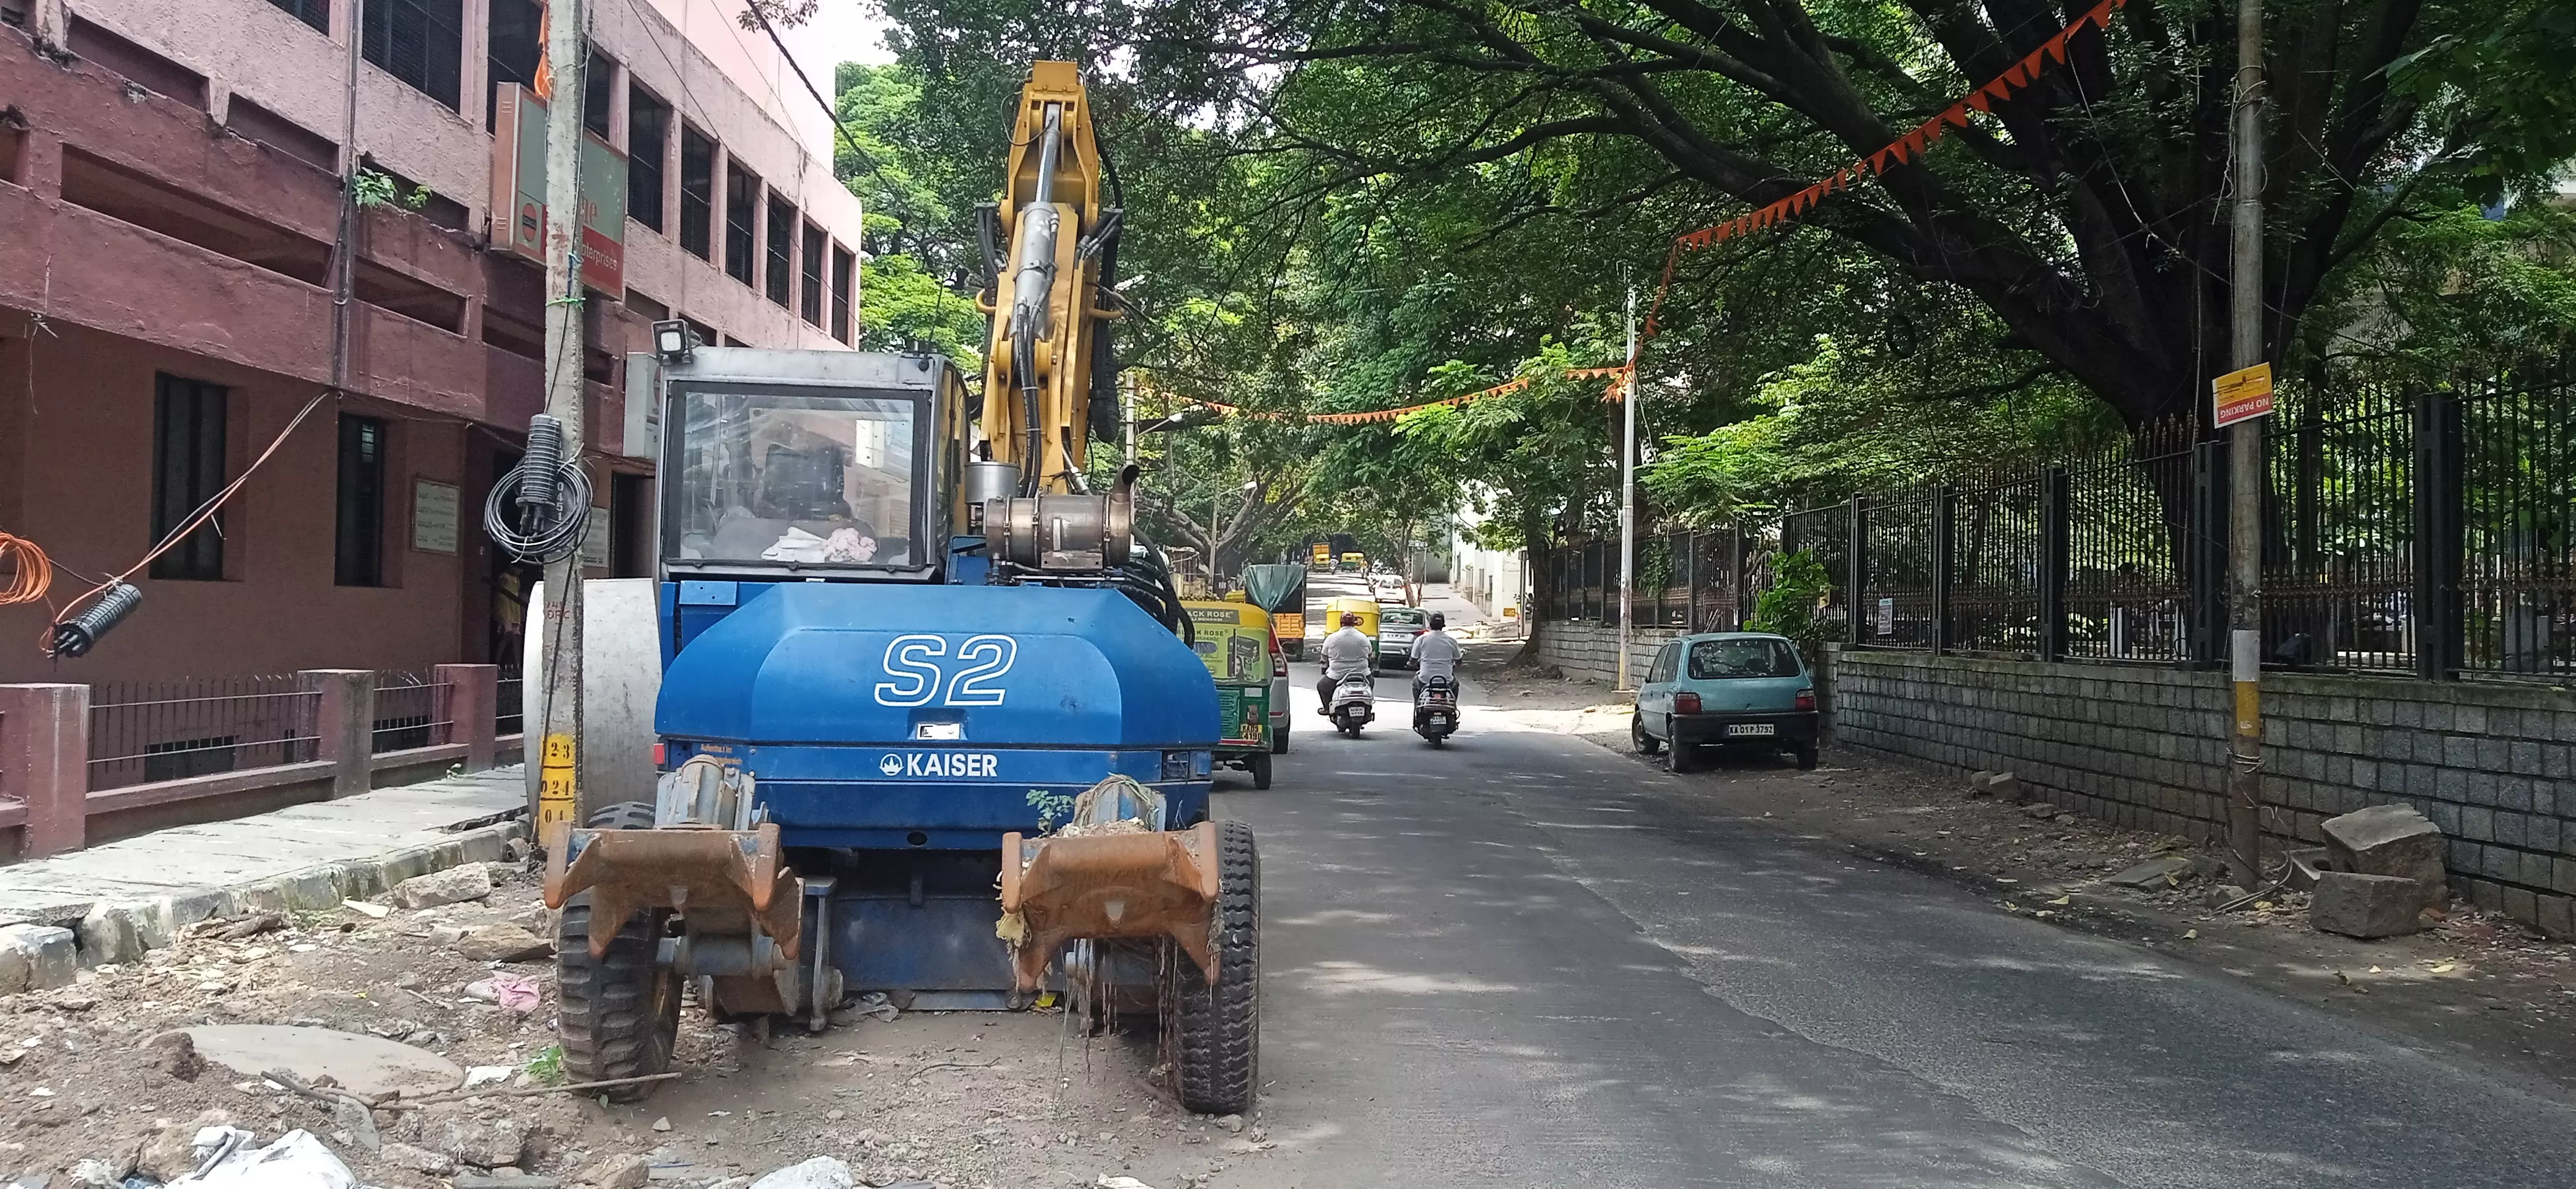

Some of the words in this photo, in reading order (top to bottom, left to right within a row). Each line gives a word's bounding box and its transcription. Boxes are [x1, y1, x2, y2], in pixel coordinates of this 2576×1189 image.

[581, 243, 617, 271] nterprises
[2220, 401, 2254, 419] PARKING
[2256, 397, 2269, 407] NO
[874, 634, 1017, 707] S2
[1756, 726, 1773, 734] 3792
[907, 753, 998, 777] KAISER
